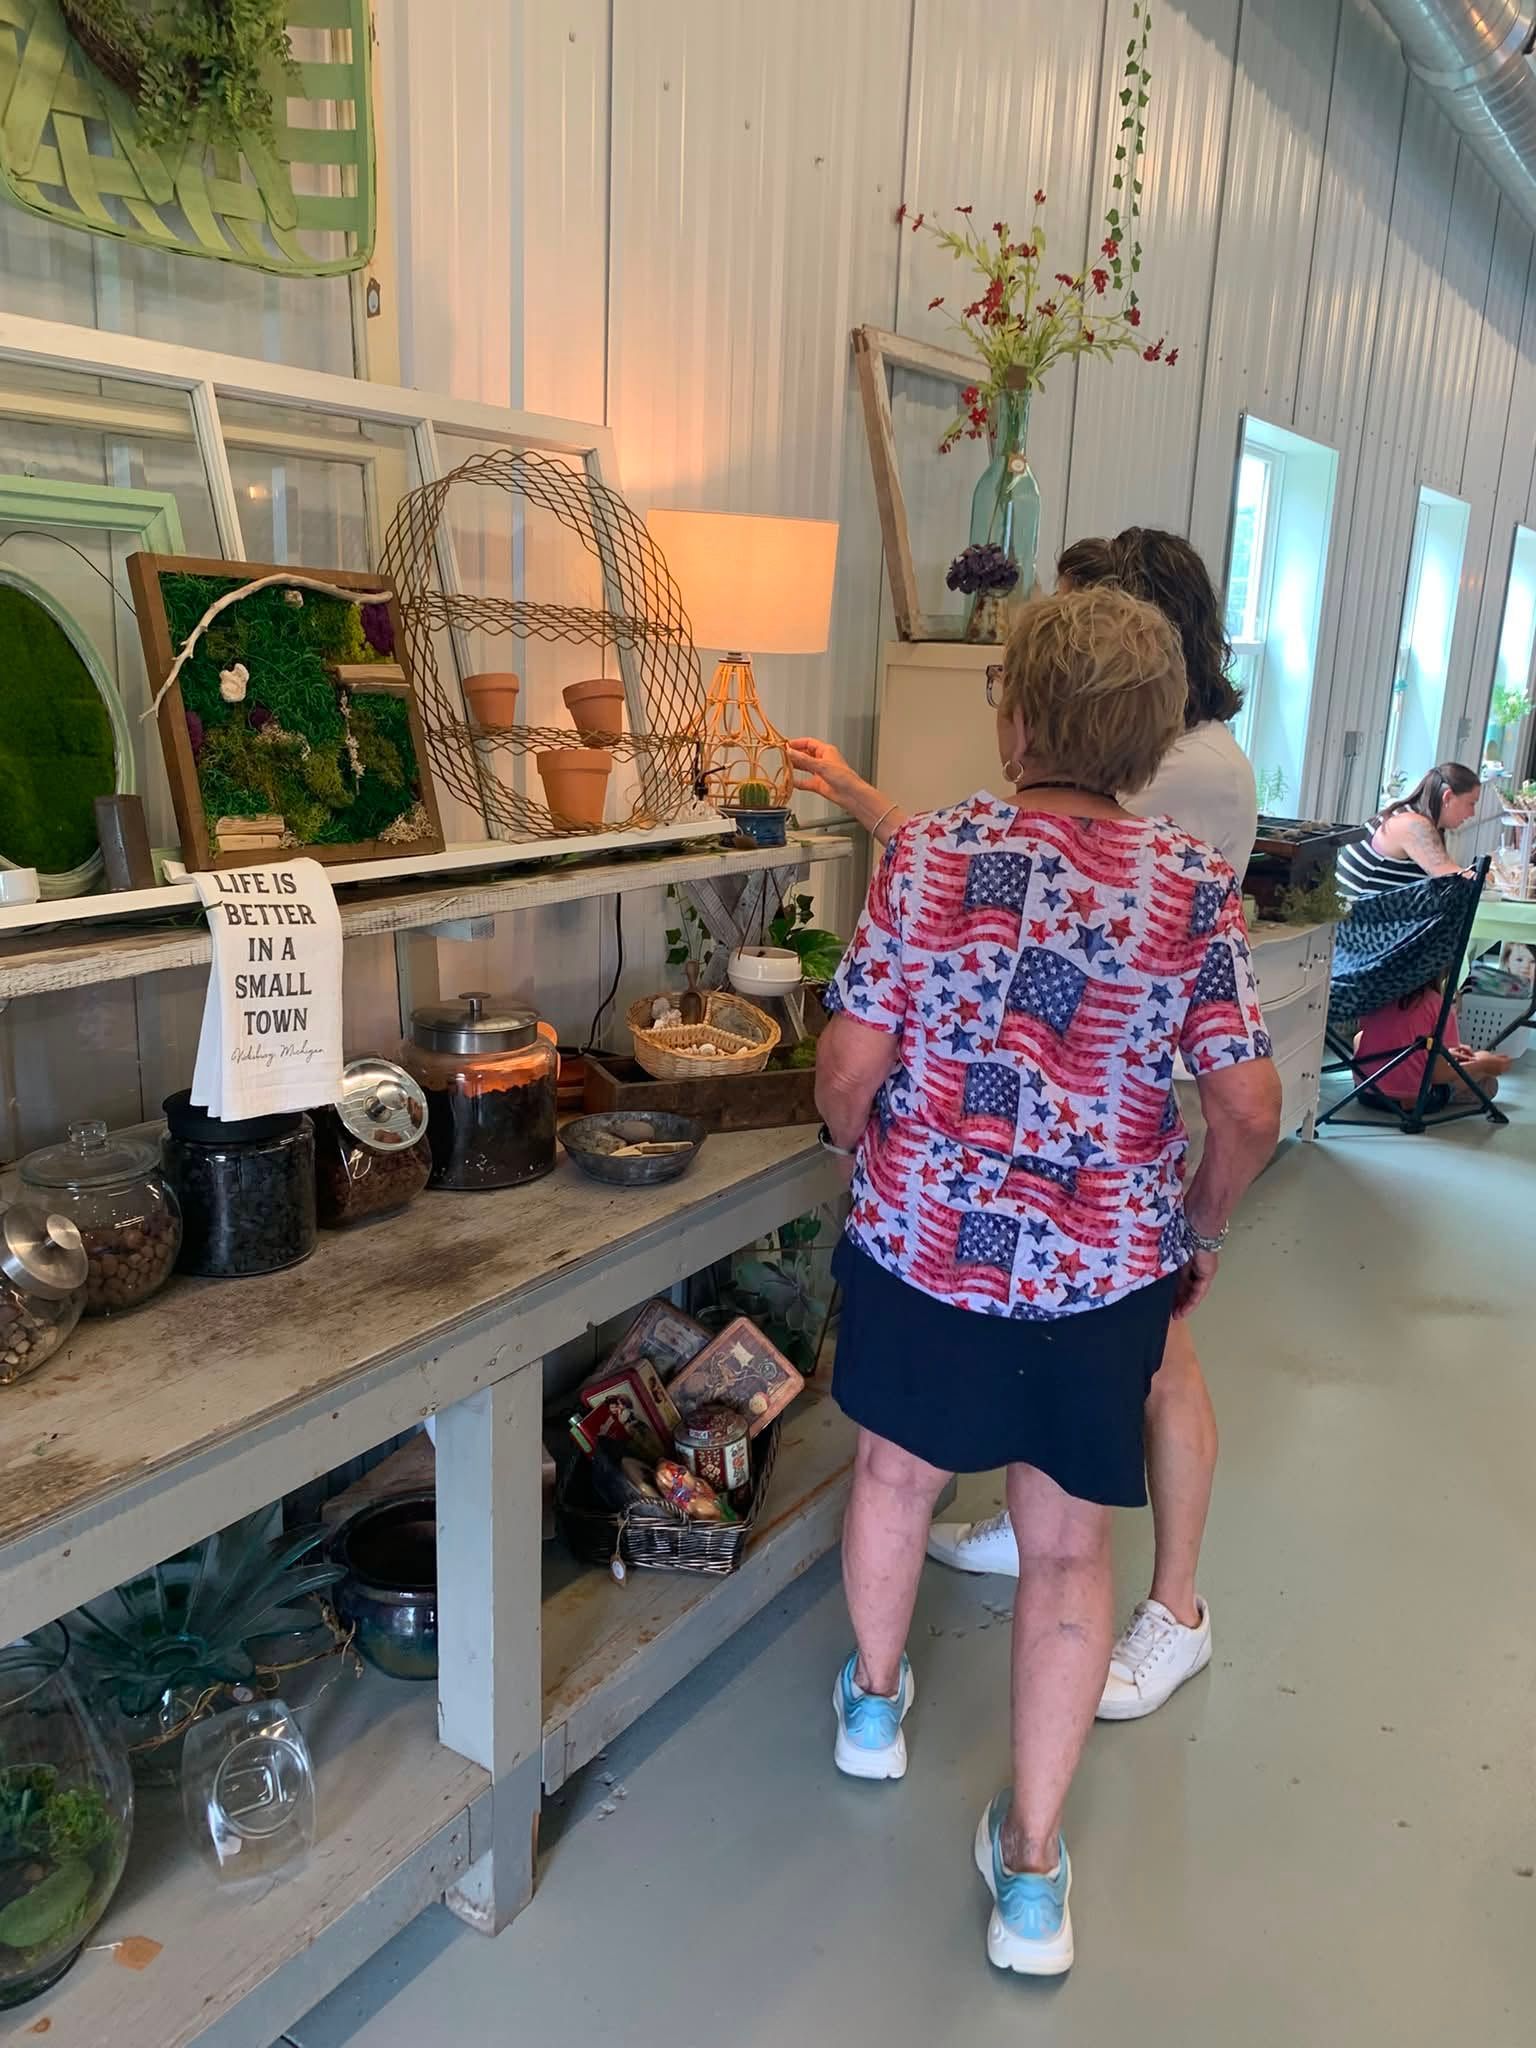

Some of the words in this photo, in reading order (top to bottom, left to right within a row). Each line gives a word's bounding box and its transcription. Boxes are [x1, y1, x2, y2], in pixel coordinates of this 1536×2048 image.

[212, 873, 270, 894] LIFE
[271, 872, 297, 894] IS
[222, 903, 317, 925] BETTER
[248, 937, 273, 961] IN
[281, 937, 296, 960] A
[235, 972, 312, 999] SMALL
[244, 1007, 308, 1035] TOWN
[280, 1040, 324, 1064] Michigan
